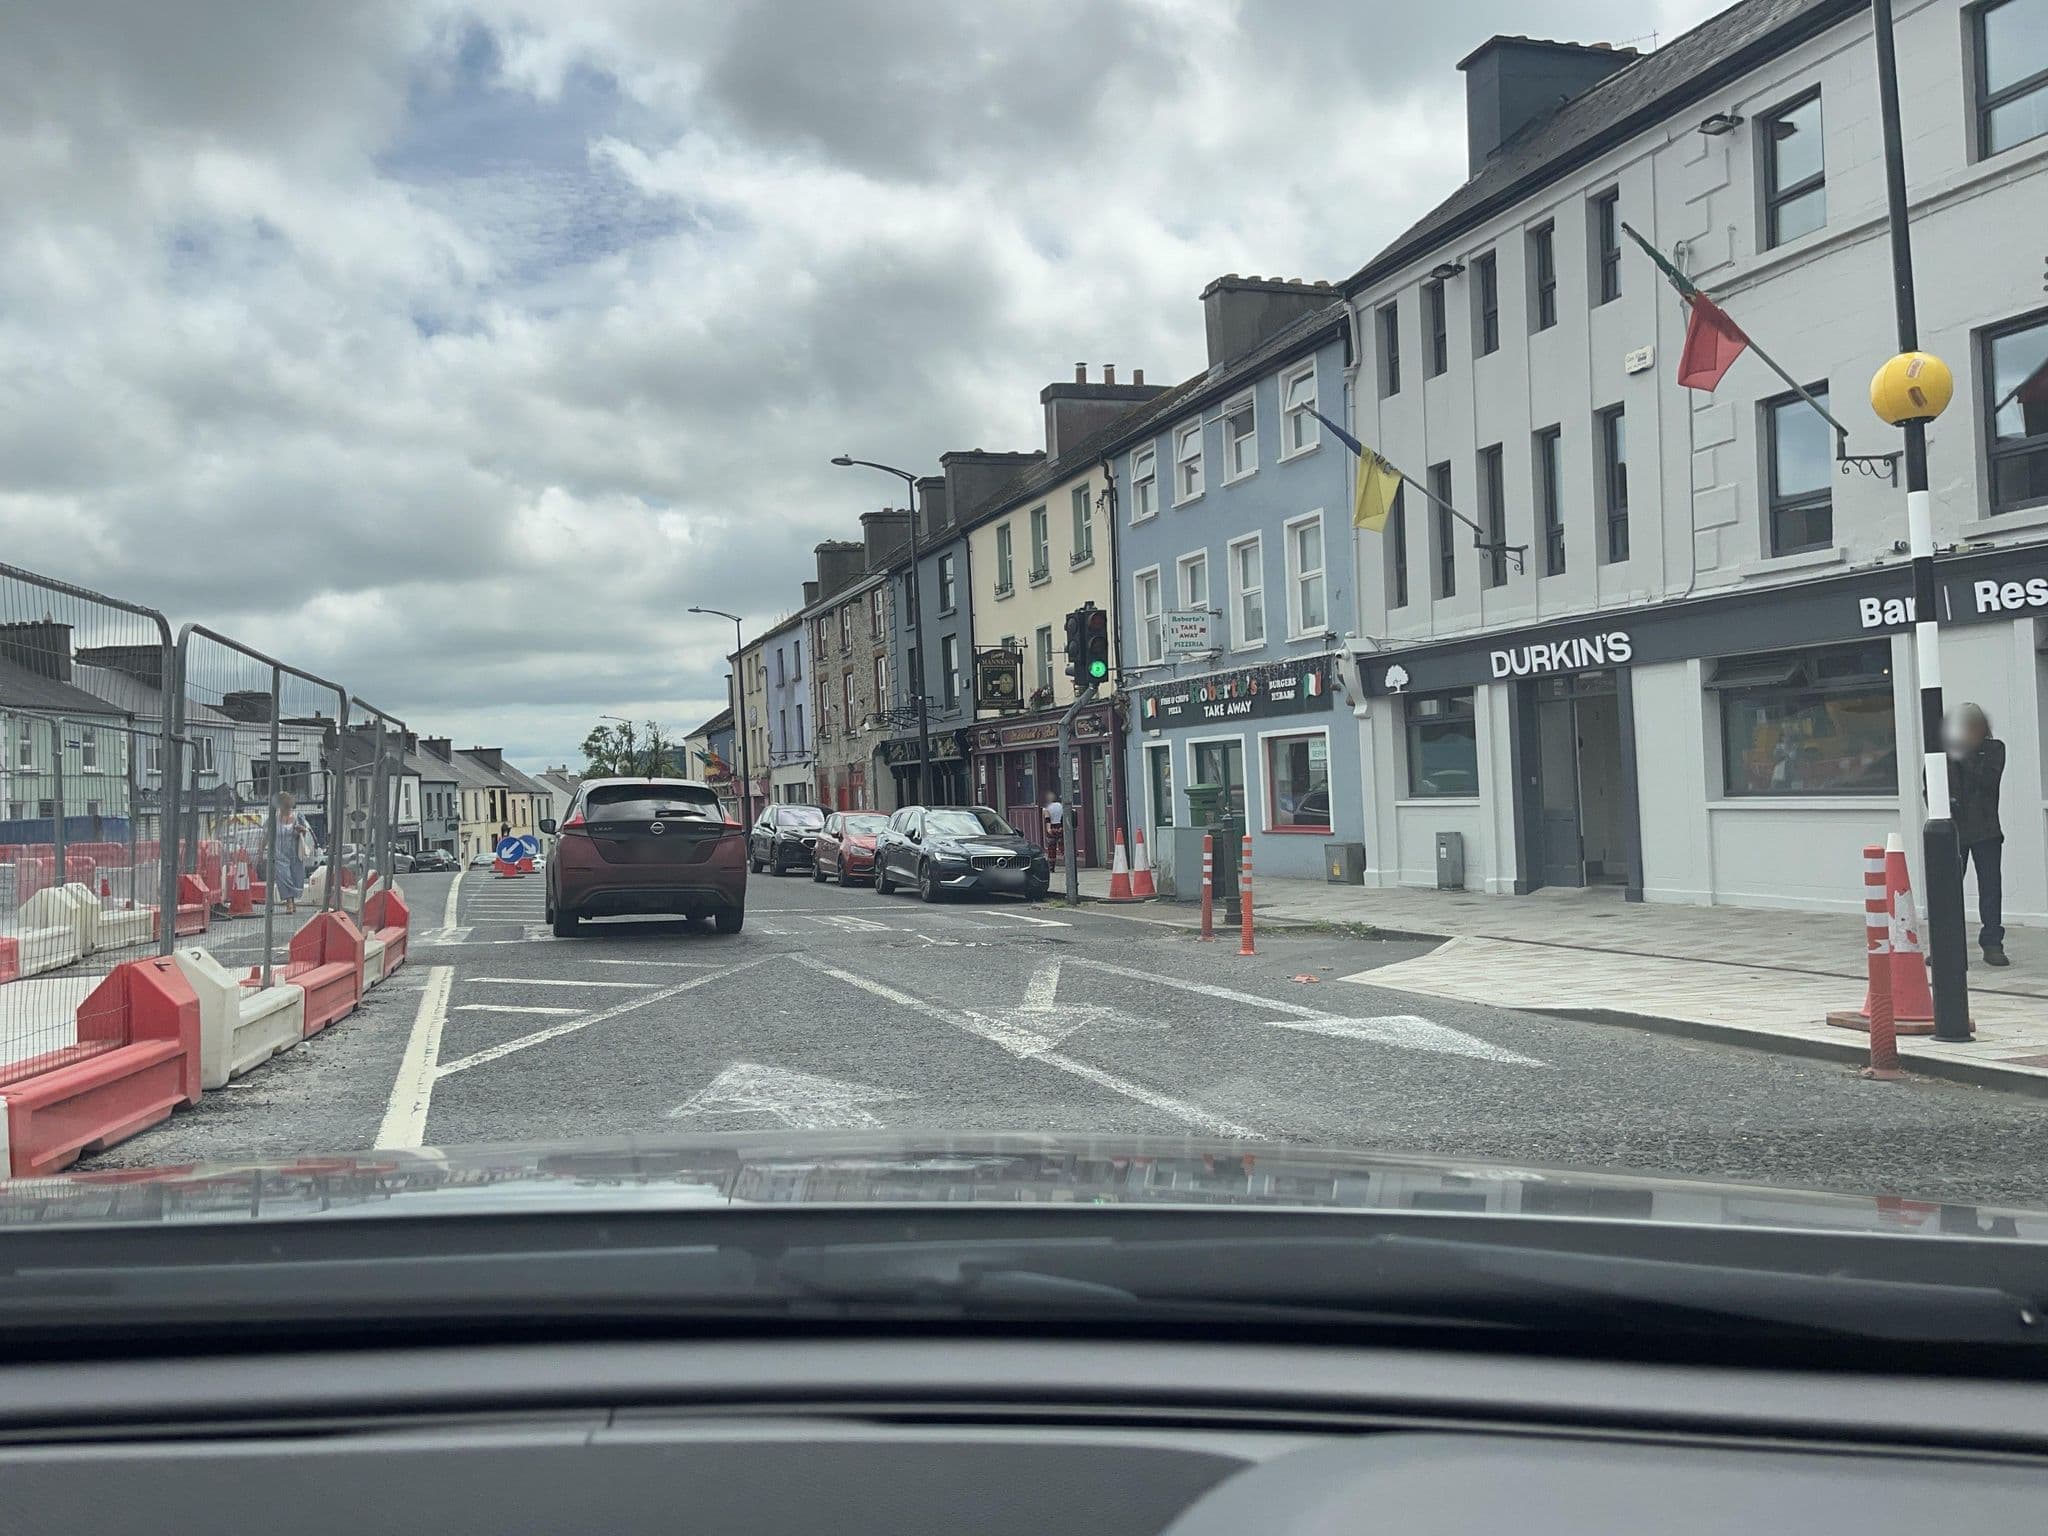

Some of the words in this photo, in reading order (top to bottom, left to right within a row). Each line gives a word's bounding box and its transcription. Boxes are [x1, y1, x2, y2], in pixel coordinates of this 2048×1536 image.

[1490, 631, 1632, 678] DURKIN'S
[1190, 676, 1258, 704] Roberto's
[1269, 677, 1297, 690] BURGERS
[1204, 704, 1225, 718] TAKE
[1227, 700, 1252, 716] AWAY
